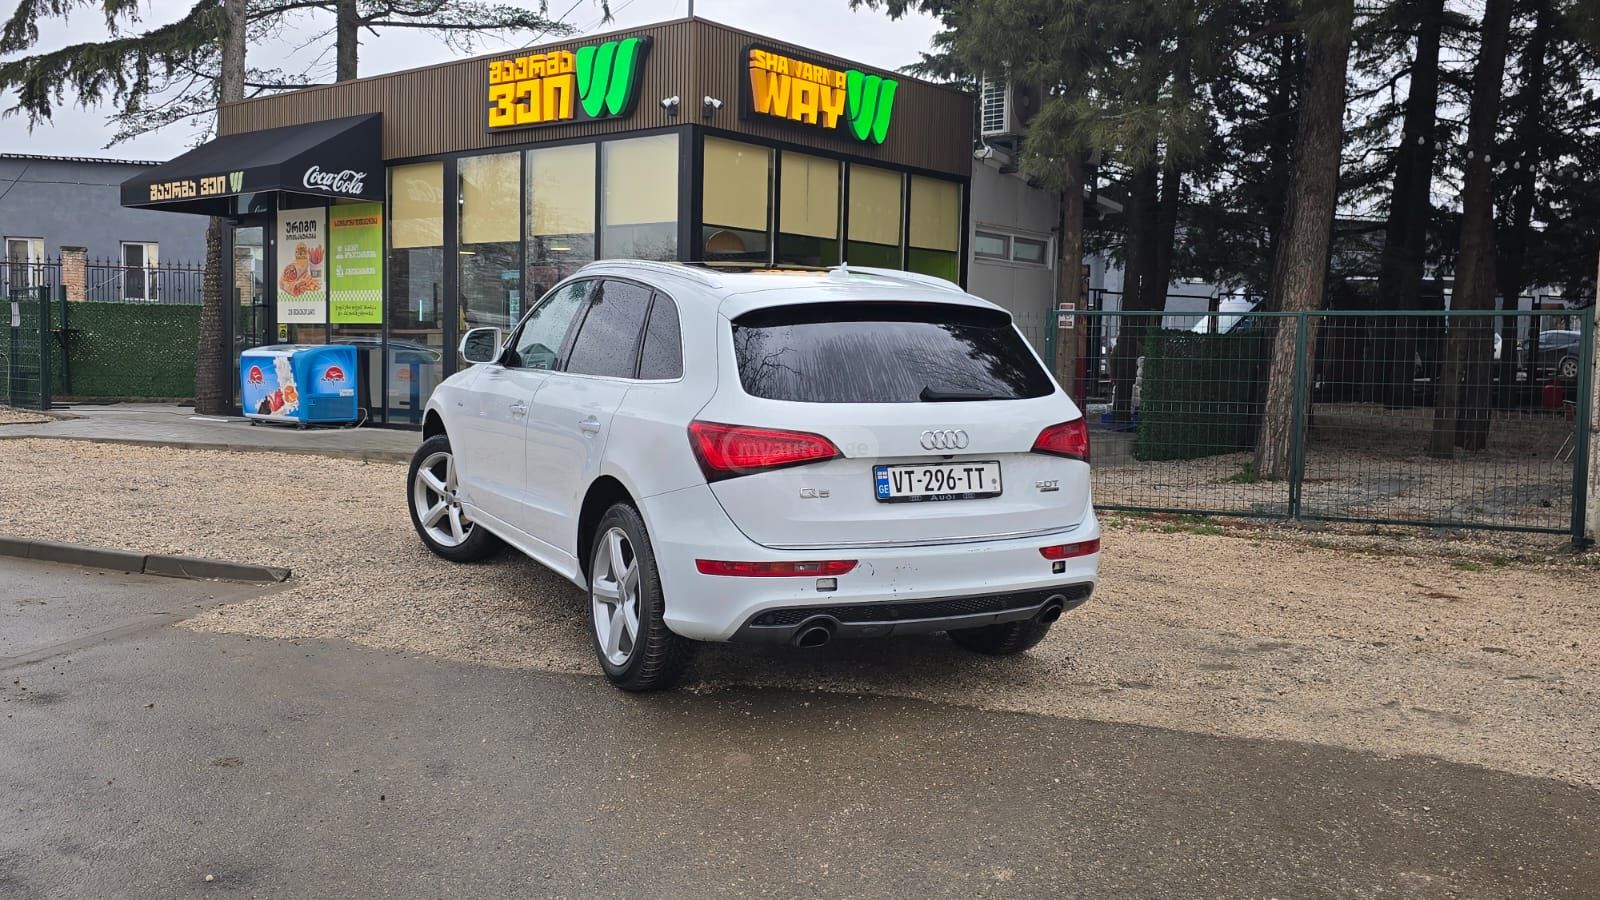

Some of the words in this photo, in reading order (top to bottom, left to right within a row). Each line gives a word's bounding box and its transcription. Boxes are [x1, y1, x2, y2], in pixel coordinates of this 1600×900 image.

[749, 49, 846, 90] SHAWARMA
[488, 74, 577, 128] ვეი
[750, 67, 847, 129] WAY
[200, 175, 226, 196] ვეი
[303, 165, 367, 195] Coca-Cola
[285, 219, 317, 235] ურიგო
[878, 484, 890, 494] GE
[892, 467, 985, 493] VT-296-TT
